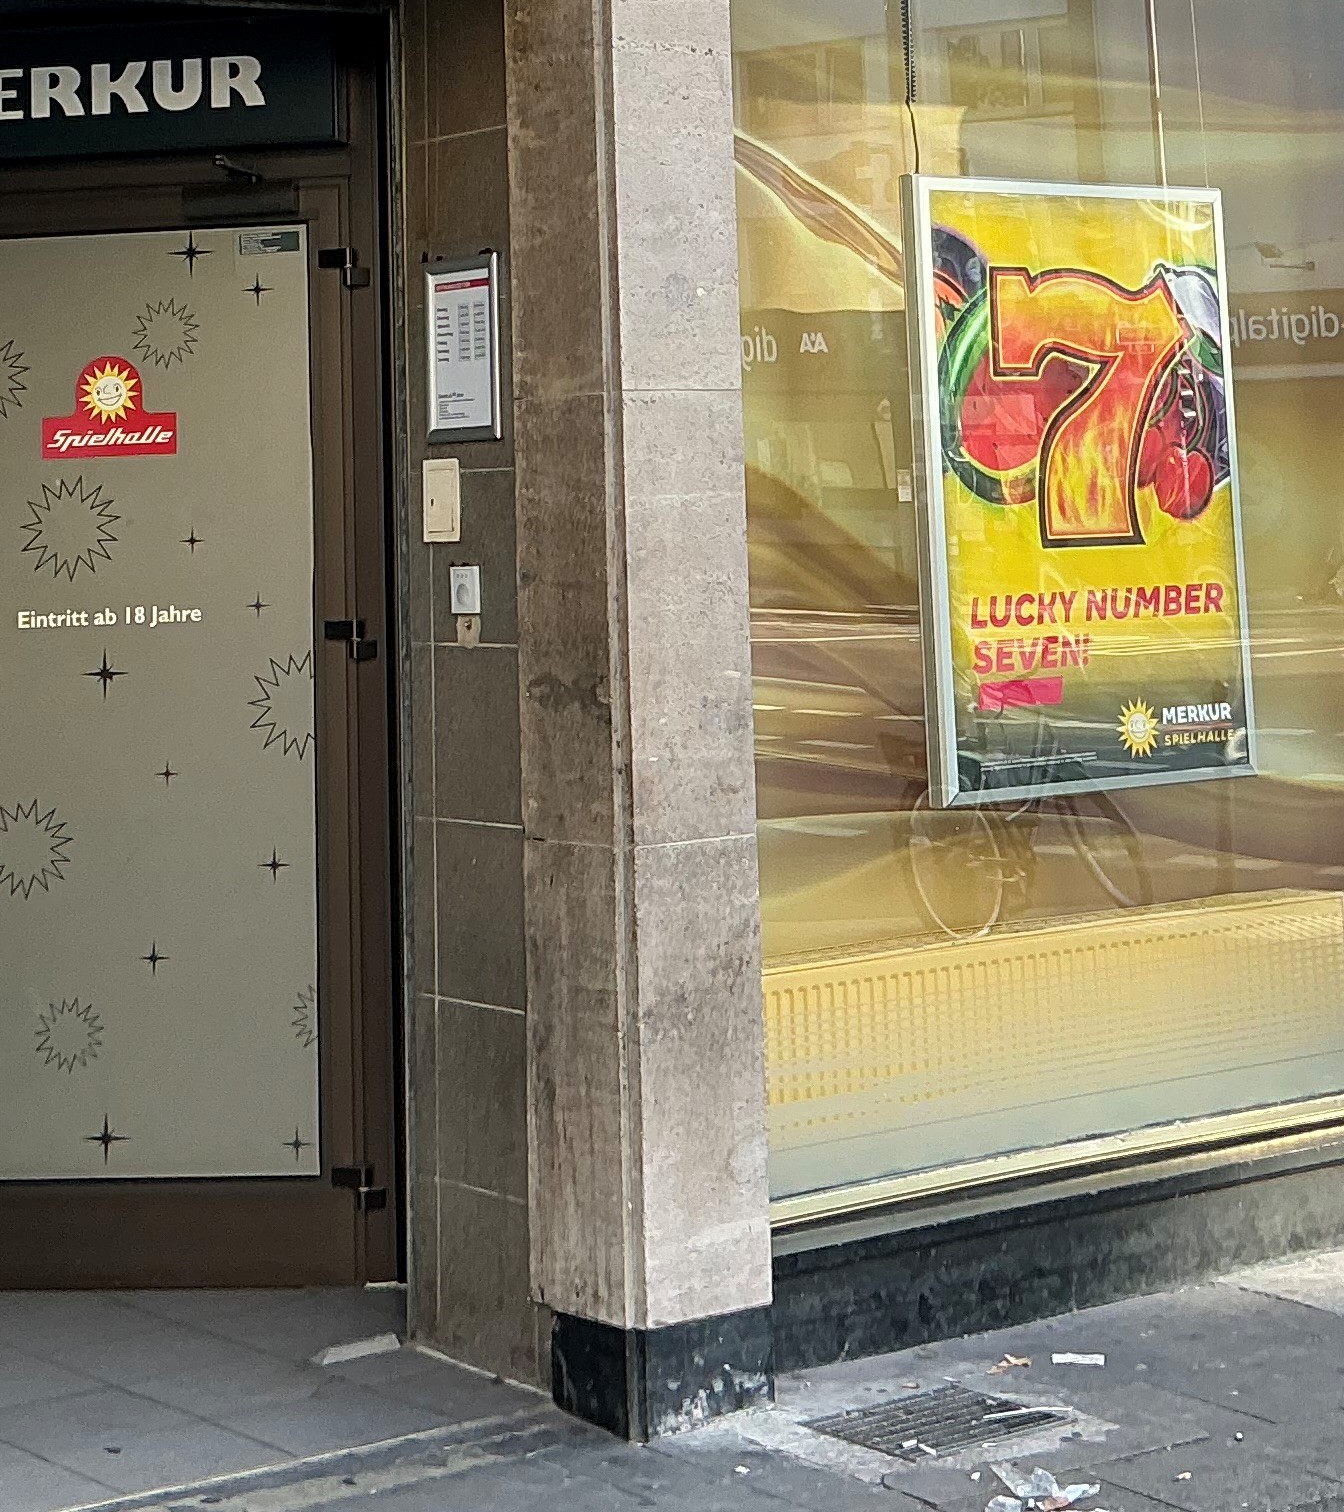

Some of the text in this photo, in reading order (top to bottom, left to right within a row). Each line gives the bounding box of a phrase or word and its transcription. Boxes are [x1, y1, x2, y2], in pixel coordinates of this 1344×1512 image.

[47, 426, 174, 453] Spielhalle
[17, 605, 202, 628] Eintritt ab 18 Jahre
[970, 582, 1224, 629] LUCKY NUMBER
[973, 634, 1091, 675] SEVEN!
[1162, 702, 1232, 725] MERKUR
[1164, 728, 1235, 746] SPIELHALLE
